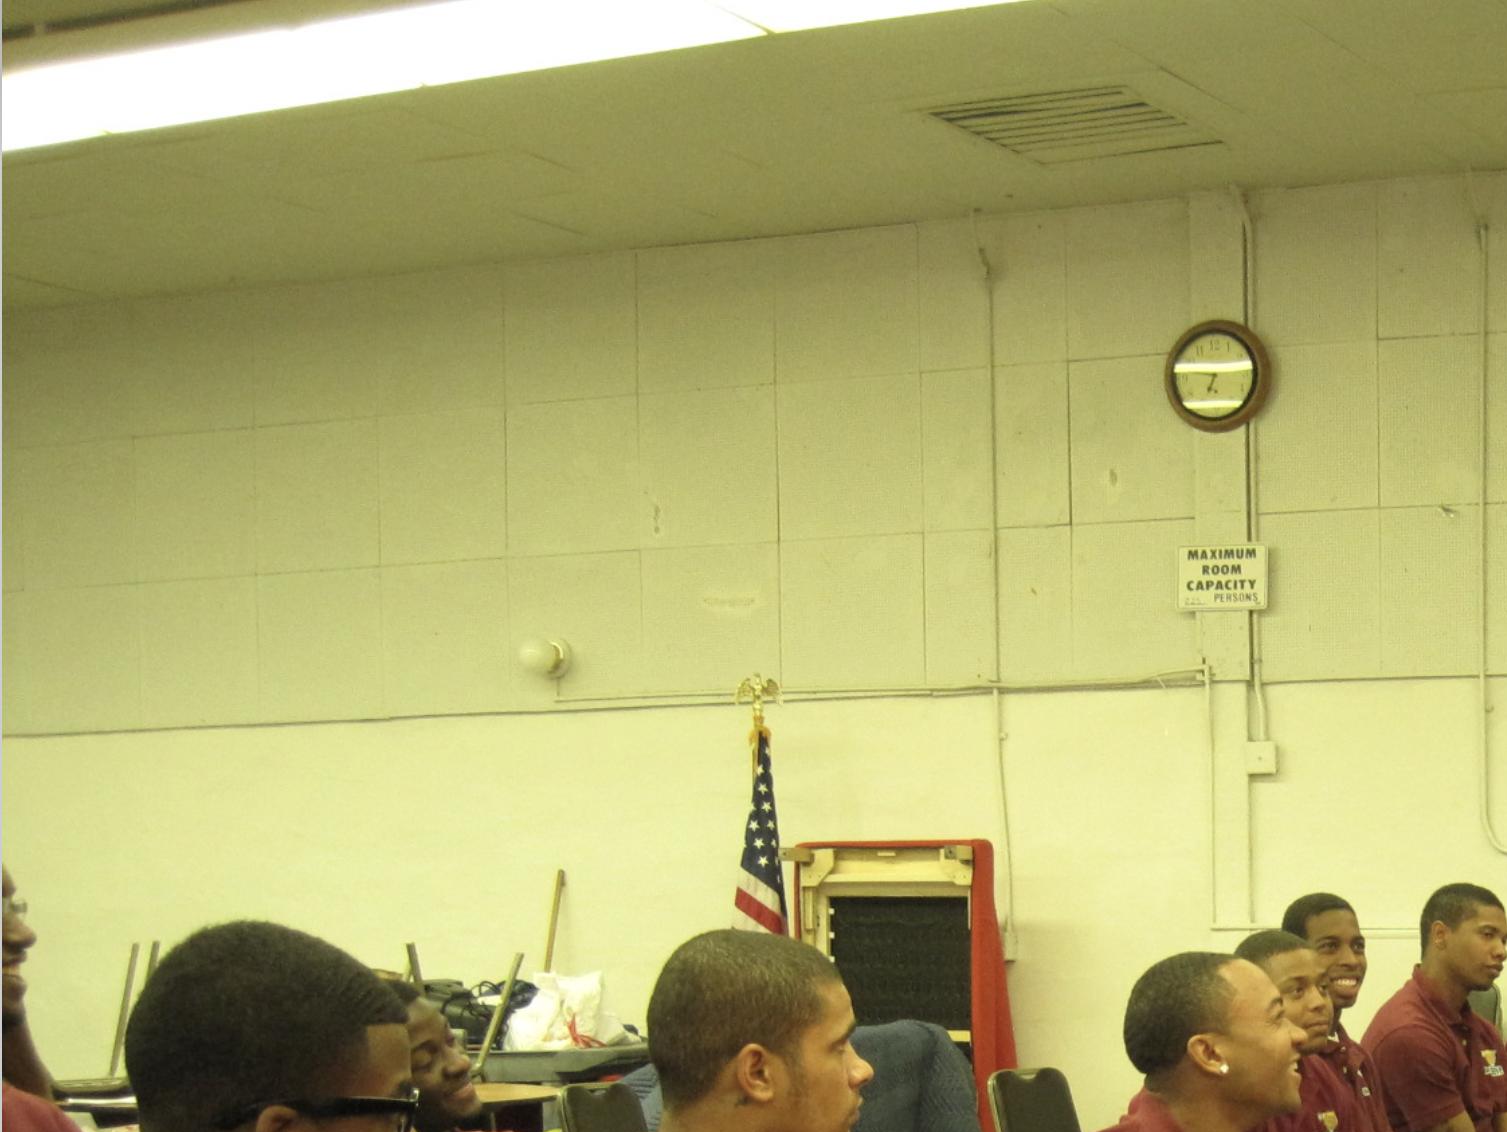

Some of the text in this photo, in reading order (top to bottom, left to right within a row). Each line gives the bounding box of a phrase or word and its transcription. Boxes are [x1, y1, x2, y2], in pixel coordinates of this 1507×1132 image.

[1187, 548, 1257, 560] MAXIMUM
[1201, 564, 1242, 576] ROOM
[1186, 579, 1257, 592] CAPACITY
[1213, 592, 1258, 602] PERSONS
